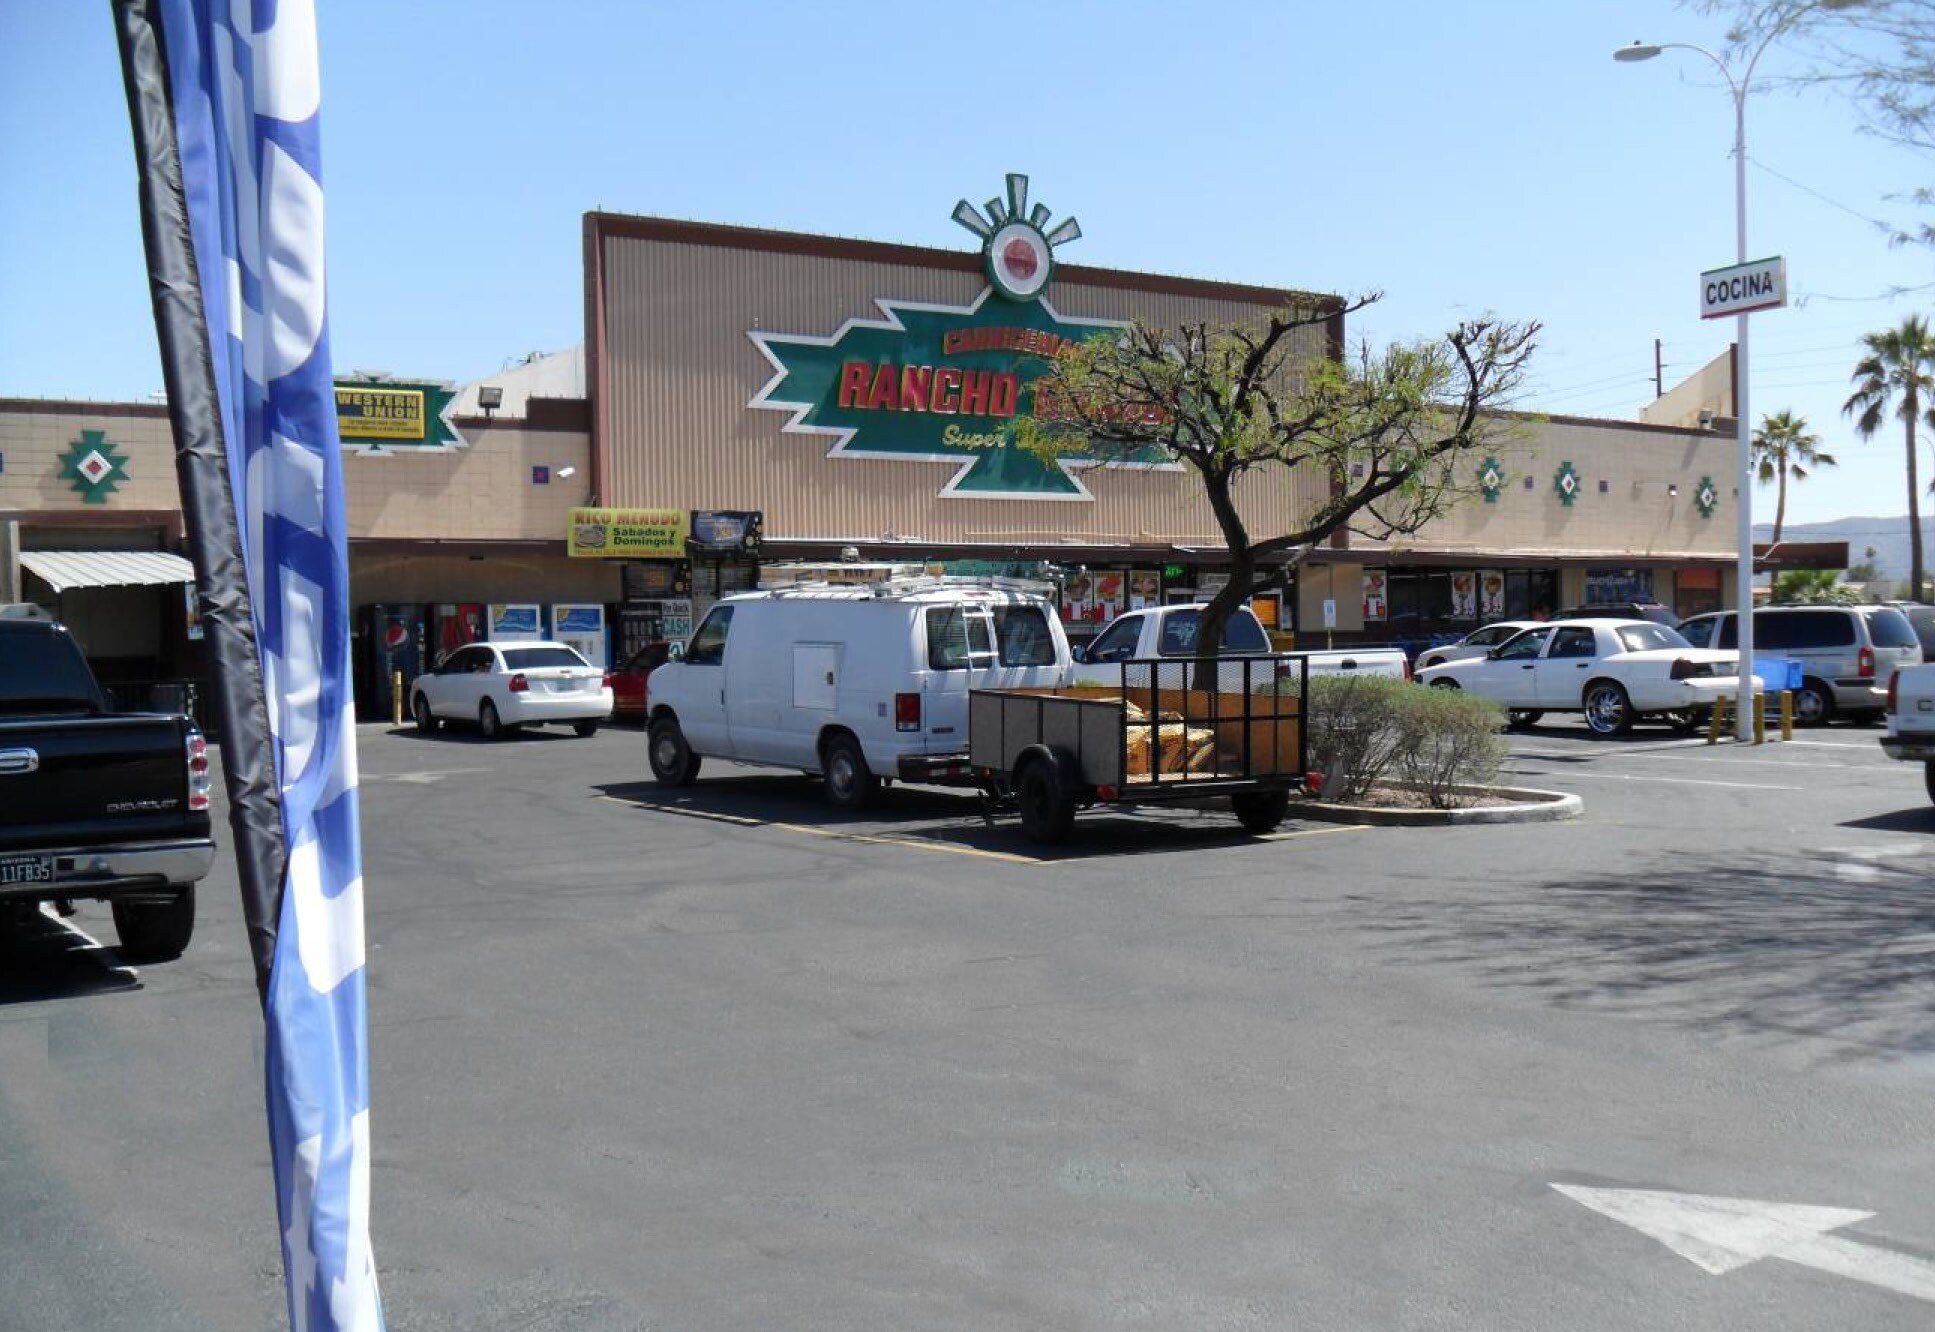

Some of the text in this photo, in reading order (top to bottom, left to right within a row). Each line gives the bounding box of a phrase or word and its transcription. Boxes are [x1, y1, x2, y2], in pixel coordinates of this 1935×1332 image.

[1706, 271, 1773, 305] COCINA
[838, 360, 1019, 416] RANCHO
[337, 392, 417, 407] WESTERN
[363, 405, 417, 419] UNION
[942, 424, 1007, 450] Super
[613, 536, 675, 547] Domingos
